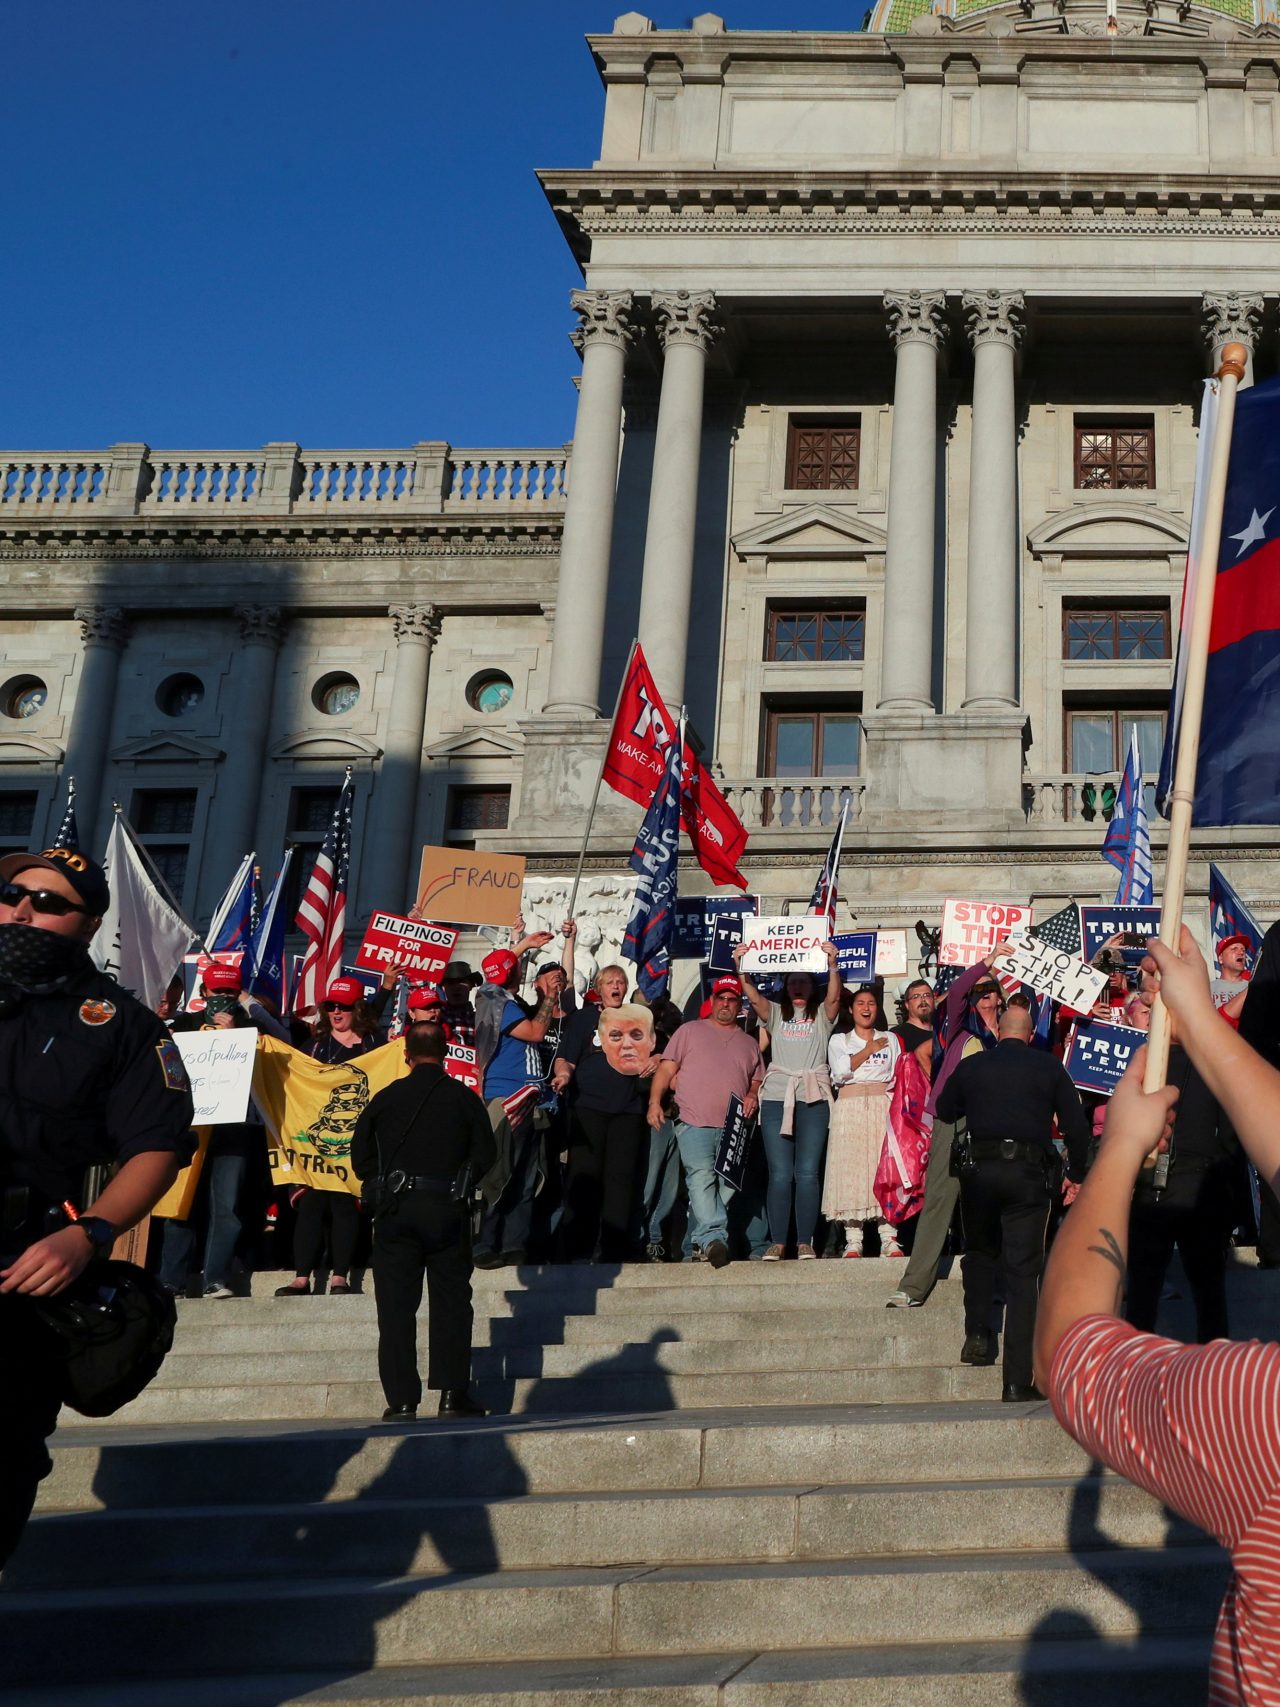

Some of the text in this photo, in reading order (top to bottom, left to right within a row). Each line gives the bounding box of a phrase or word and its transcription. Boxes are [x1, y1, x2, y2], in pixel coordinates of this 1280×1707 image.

[616, 739, 648, 766] MAKE
[453, 867, 521, 889] FRAUD
[953, 902, 1022, 927] STOP
[375, 916, 453, 945] FILIPINOS
[767, 924, 804, 936] KEEP
[1086, 921, 1160, 935] TRUM
[397, 939, 421, 952] FOR
[748, 937, 822, 951] AMERICA
[363, 943, 446, 973] TRUMP
[1018, 934, 1093, 979] STOP
[1030, 955, 1065, 983] THE
[1002, 958, 1084, 1006] STEAL!
[212, 1043, 248, 1067] pulling
[1076, 1034, 1131, 1058] TRU
[1081, 1052, 1128, 1070] PEN
[1088, 1065, 1104, 1074] KEEP
[722, 1103, 744, 1173] TRUMP
